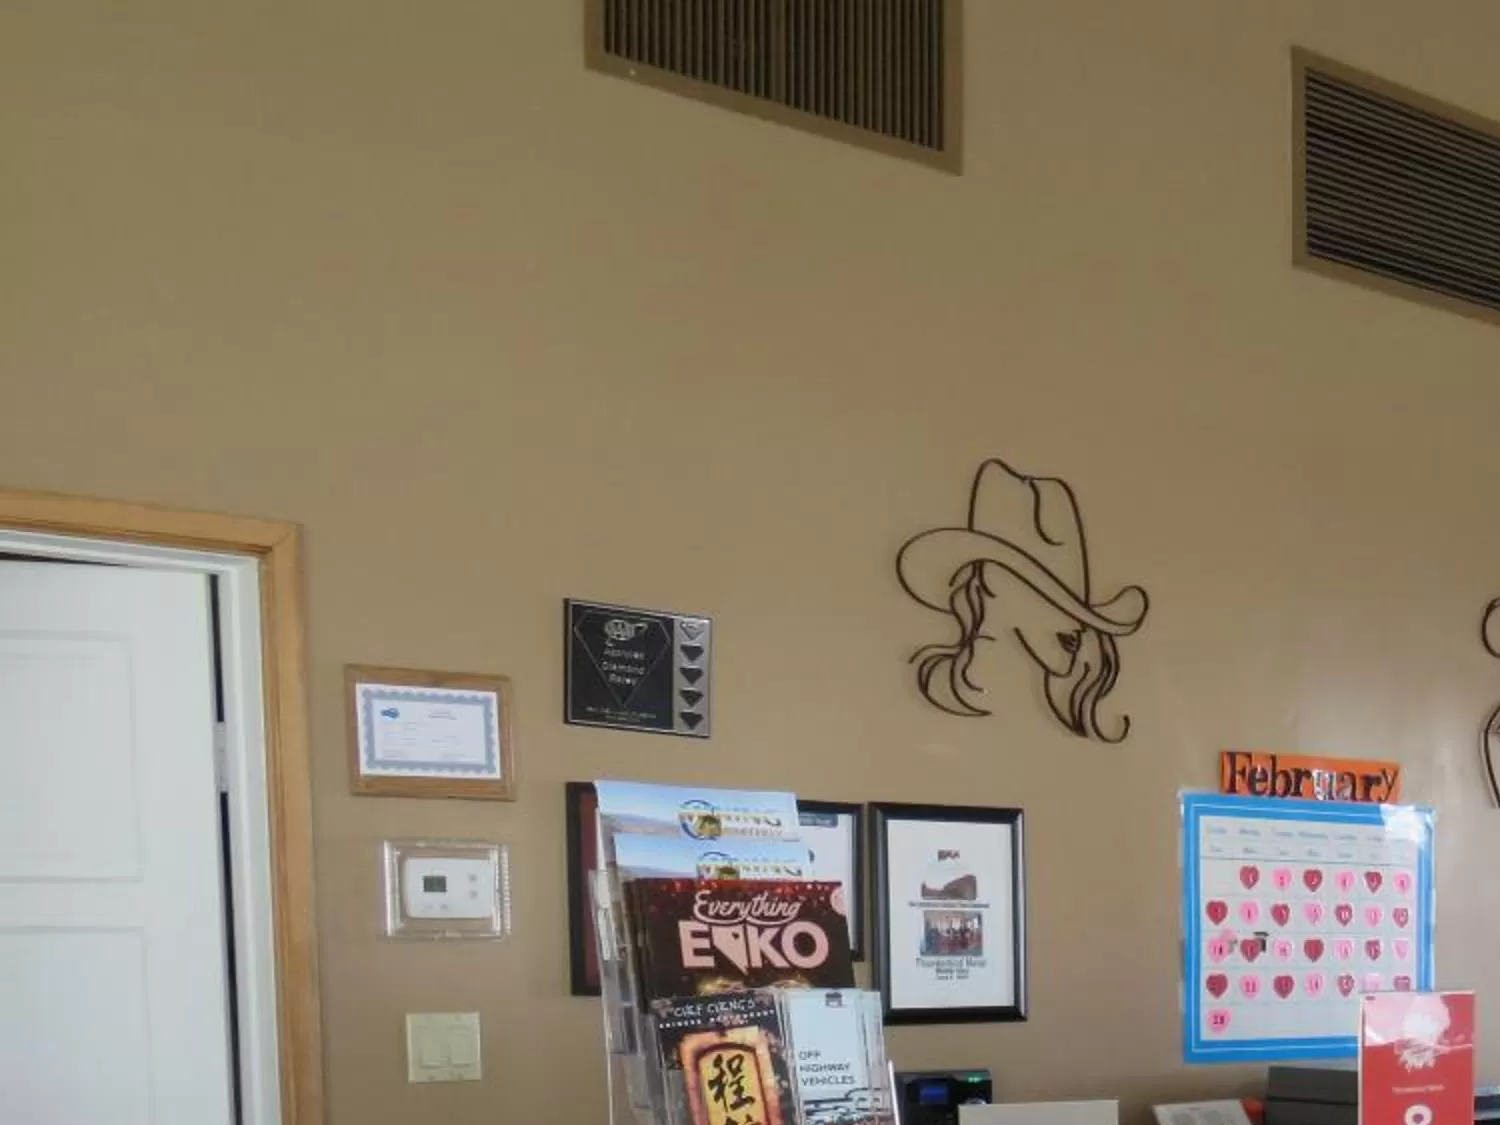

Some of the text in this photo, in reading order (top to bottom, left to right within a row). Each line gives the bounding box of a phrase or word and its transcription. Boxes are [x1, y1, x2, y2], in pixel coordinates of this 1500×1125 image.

[1225, 751, 1399, 802] February
[693, 889, 803, 926] Everything
[673, 1004, 703, 1018] CHEF
[798, 1050, 822, 1060] OFF
[799, 1061, 851, 1073] HIGHWAY
[801, 1075, 856, 1087] VEHICLES
